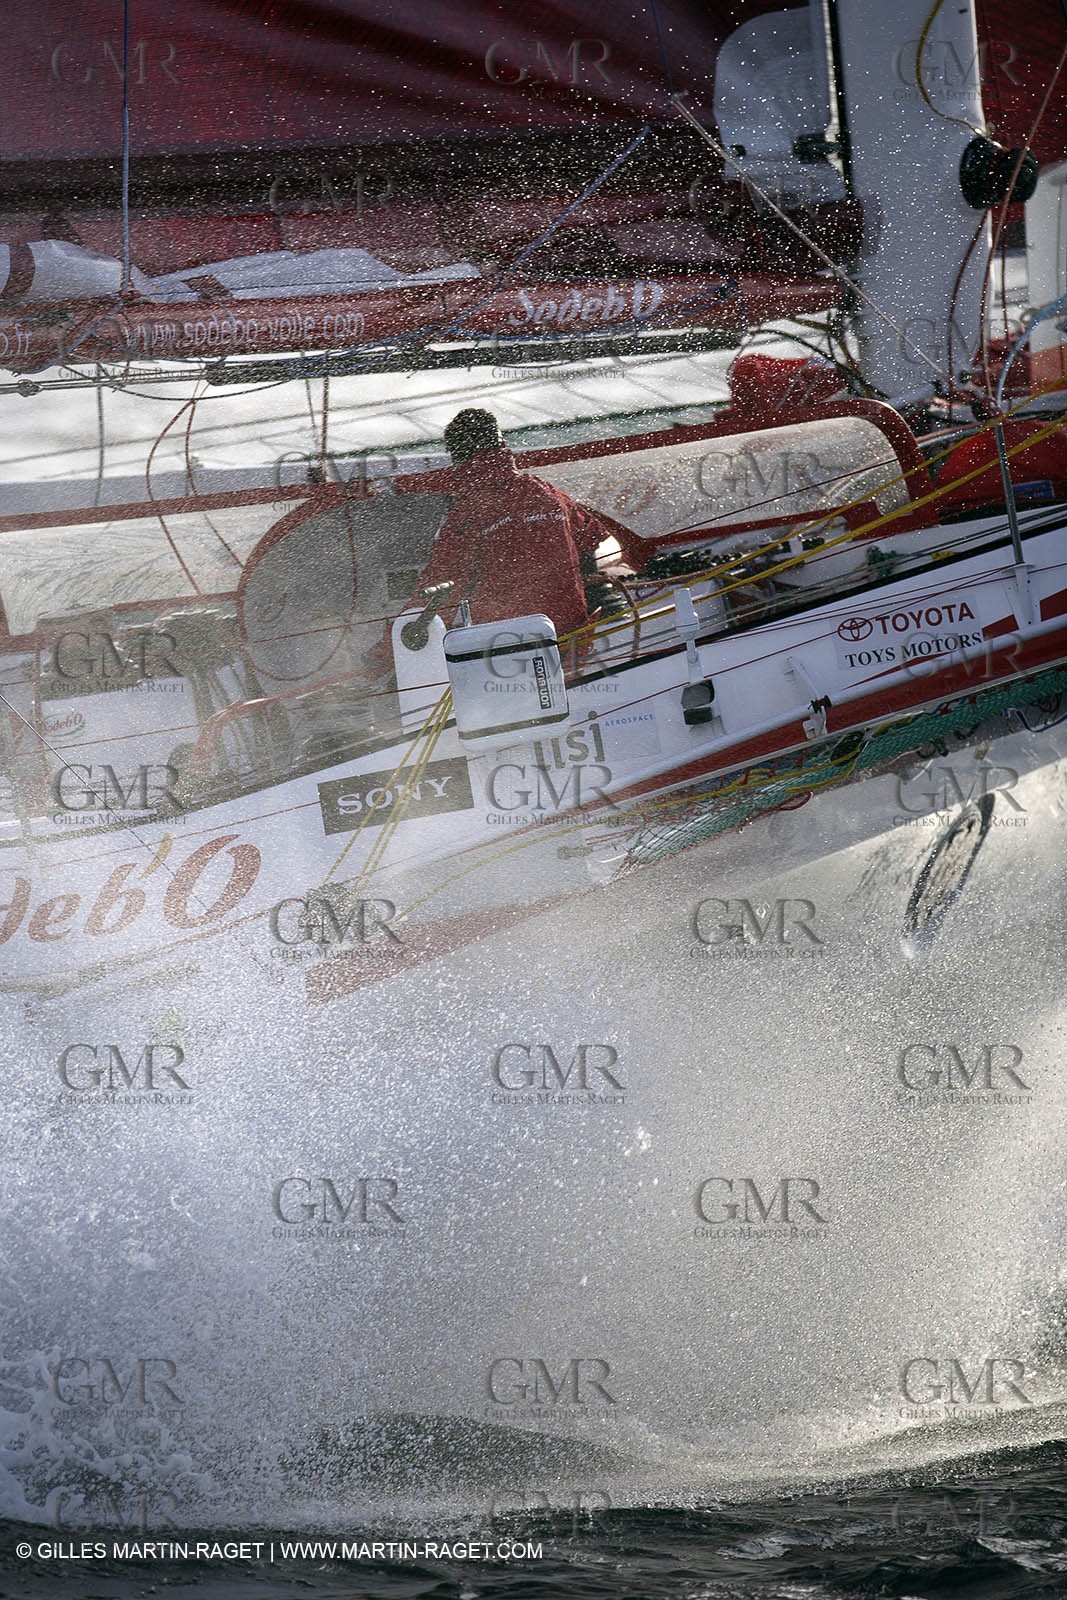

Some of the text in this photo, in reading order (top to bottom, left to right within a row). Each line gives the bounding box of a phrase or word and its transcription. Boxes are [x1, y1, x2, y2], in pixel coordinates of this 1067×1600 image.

[123, 309, 366, 349] www.sodebo-voile.com
[874, 602, 975, 634] TOYOTA
[845, 632, 983, 668] TOYS MOTORS
[603, 713, 655, 728] AEROSPACE
[336, 776, 453, 815] SONY
